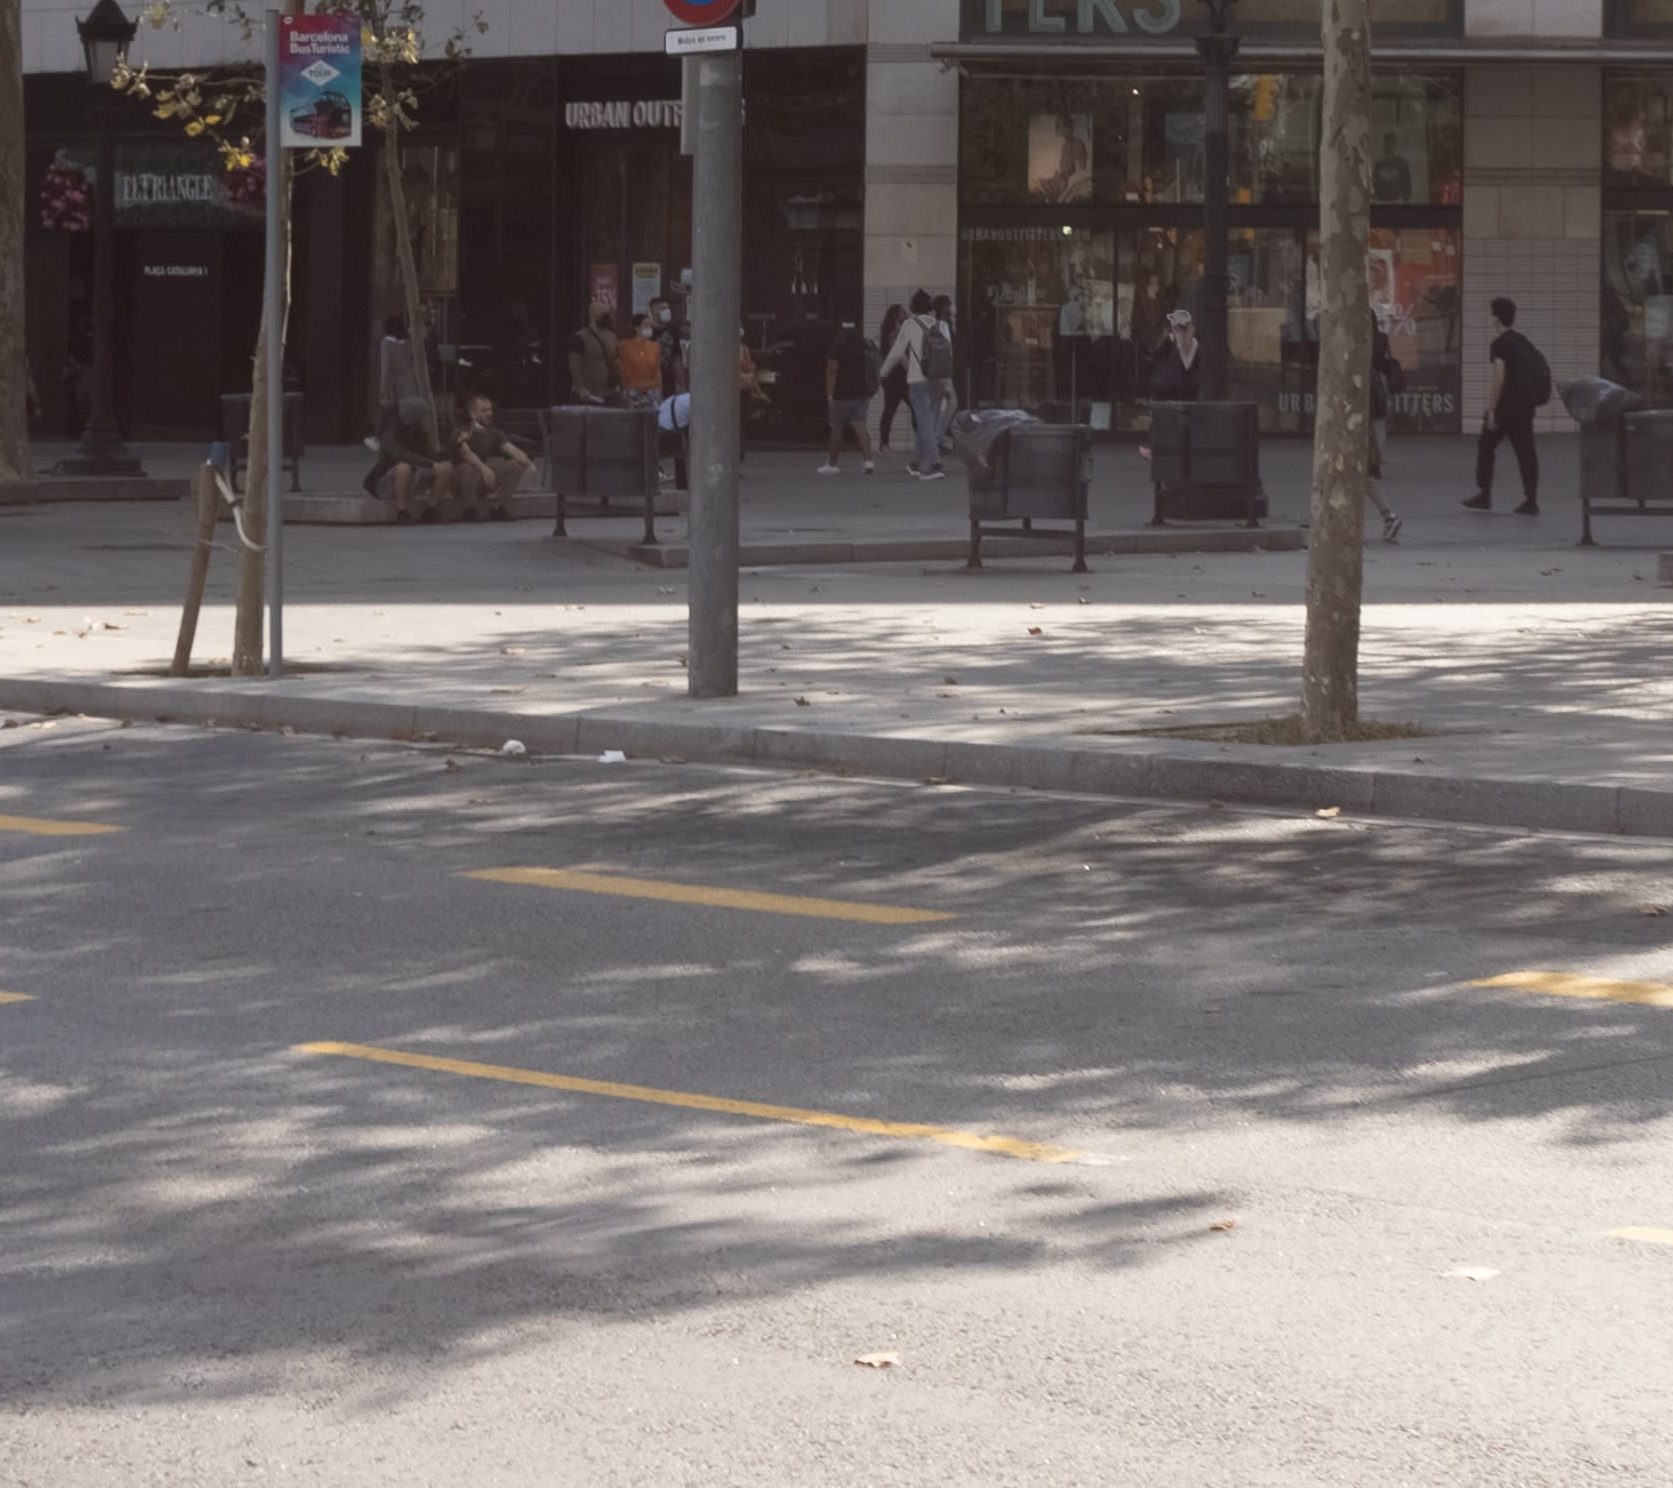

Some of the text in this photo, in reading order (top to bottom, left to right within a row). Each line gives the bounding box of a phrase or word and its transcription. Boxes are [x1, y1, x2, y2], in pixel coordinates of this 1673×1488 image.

[289, 30, 349, 43] Barcelona
[565, 100, 631, 129] URBAN
[138, 173, 214, 202] TRIANGLE
[1278, 392, 1455, 414] URB FITTERS
